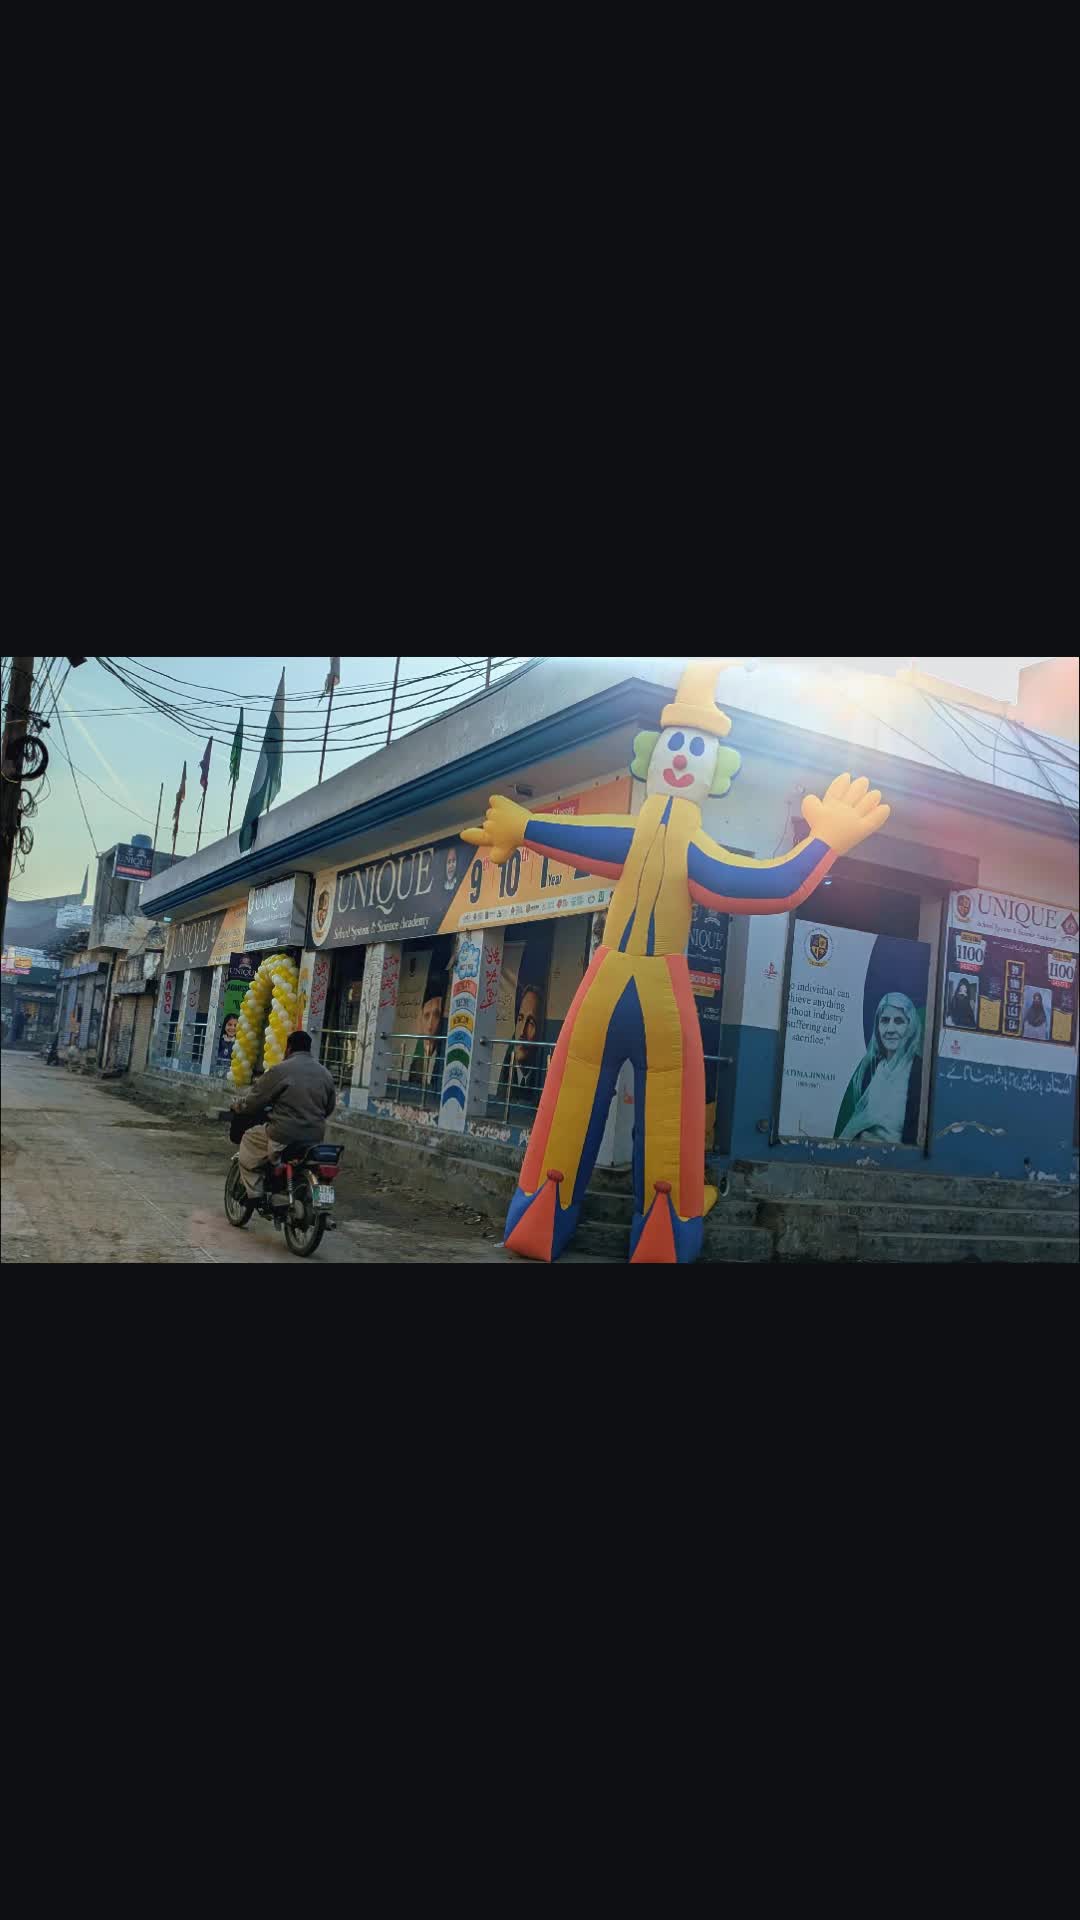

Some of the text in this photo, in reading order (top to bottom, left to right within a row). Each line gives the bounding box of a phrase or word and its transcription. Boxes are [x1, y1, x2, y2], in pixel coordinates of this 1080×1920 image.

[337, 848, 434, 915] UNIQUE
[548, 874, 562, 887] Year
[978, 893, 1058, 928] UNIQUE
[377, 918, 400, 932] Science
[400, 913, 431, 930] Academy
[173, 919, 211, 963] UNIQUE
[690, 928, 725, 952] NIQUE
[957, 944, 984, 963] 1100
[229, 967, 256, 977] UNIQU
[1050, 962, 1074, 980] 1100
[797, 981, 835, 996] individual
[838, 990, 850, 999] can
[812, 998, 845, 1012] anything
[813, 1009, 843, 1025] industry
[823, 1025, 837, 1034] and
[809, 1071, 836, 1081] JINNAH
